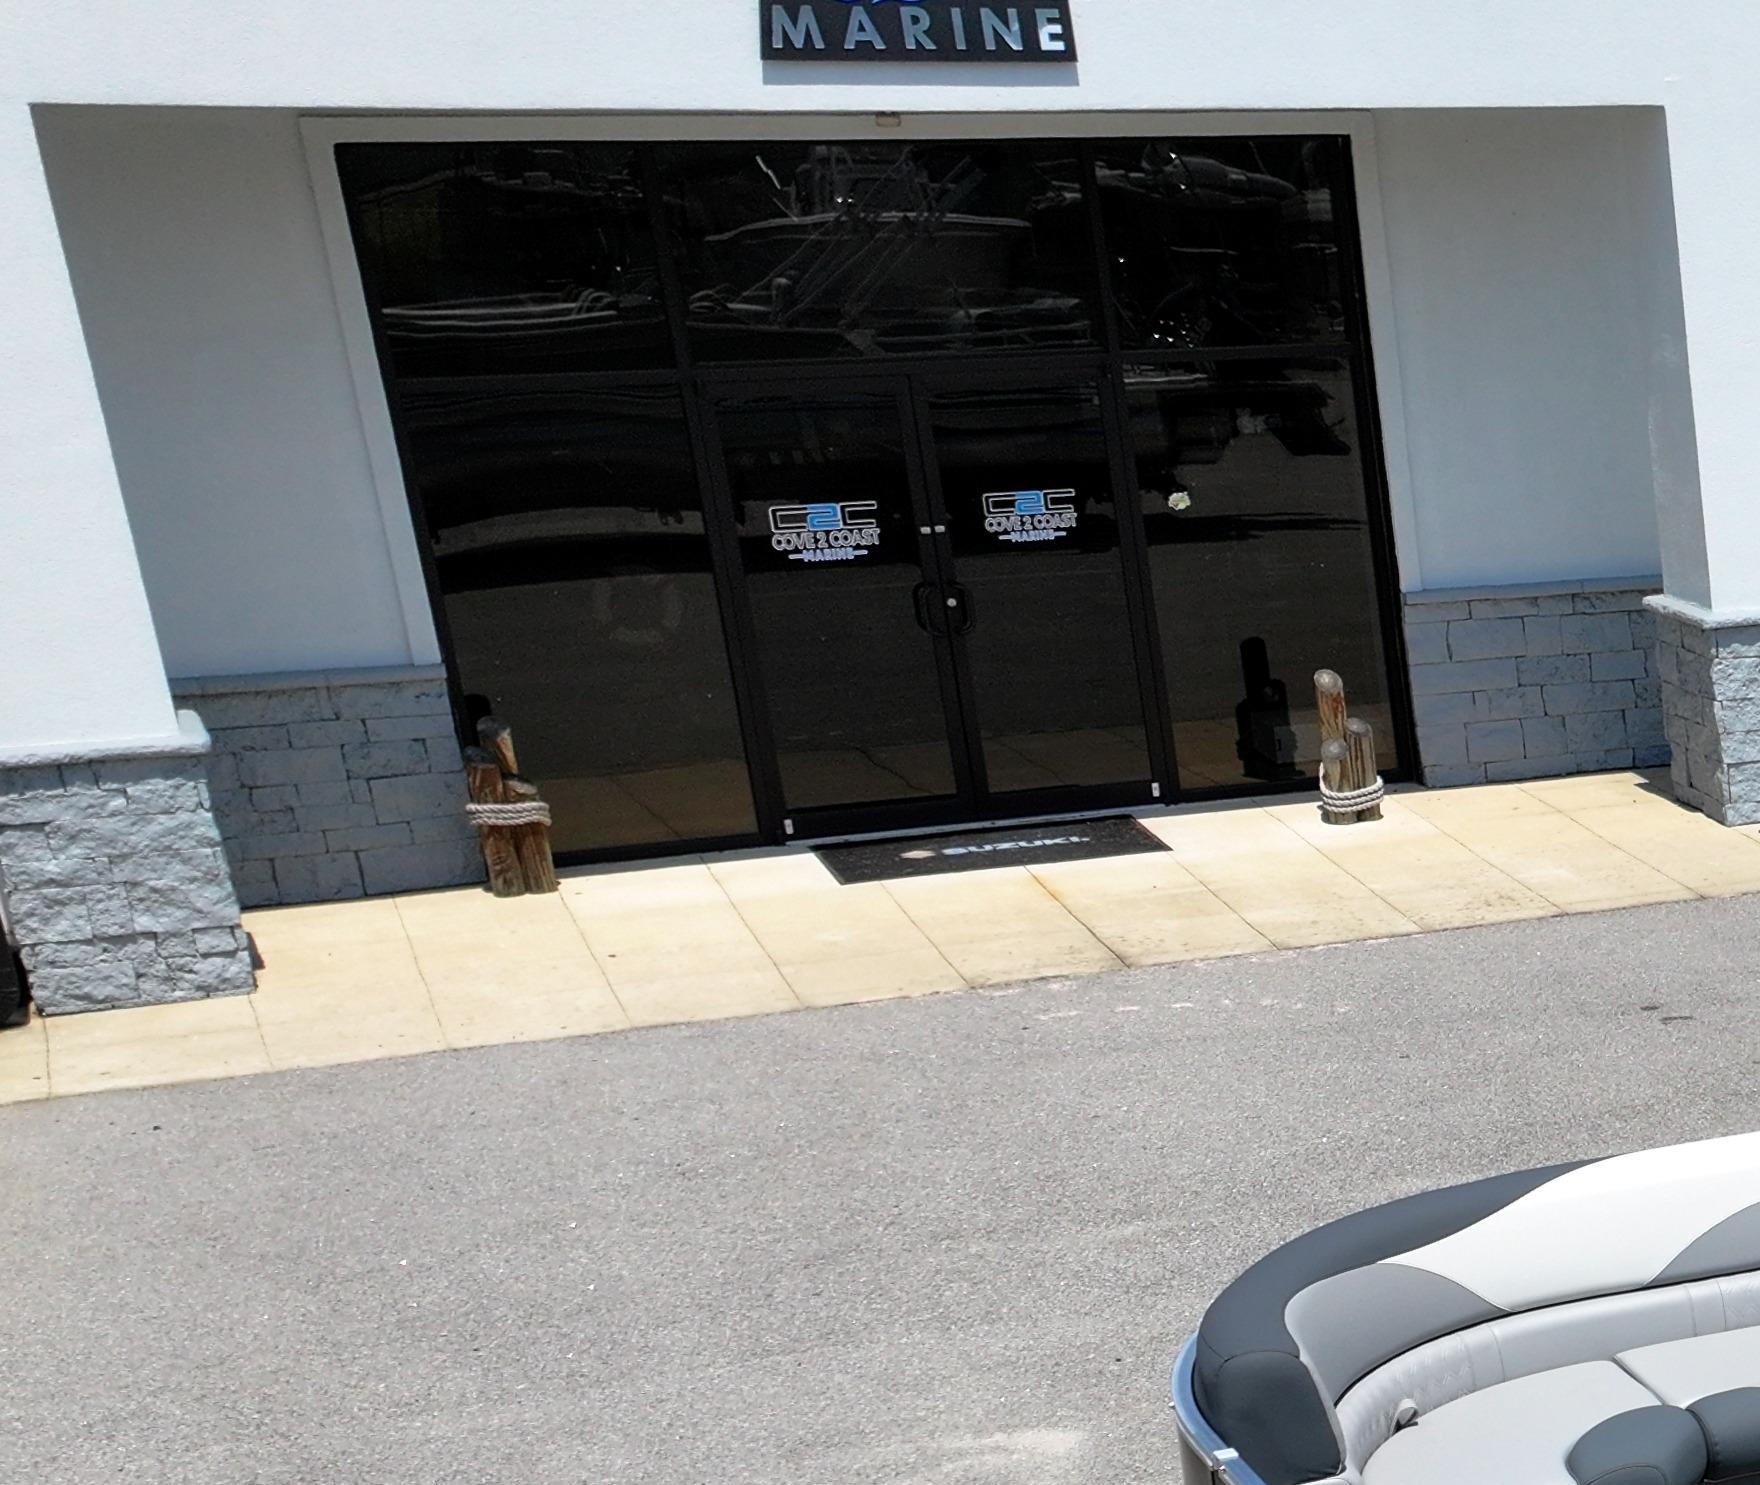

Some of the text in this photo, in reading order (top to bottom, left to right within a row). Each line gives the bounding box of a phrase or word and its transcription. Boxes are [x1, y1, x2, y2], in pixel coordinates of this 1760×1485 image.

[771, 5, 1066, 51] MARINE
[982, 488, 1076, 517] C2C
[768, 500, 878, 533] C2C
[984, 512, 1078, 533] COVE 2 COAST
[771, 528, 880, 551] COVE 2 COAST
[1010, 529, 1055, 542] MARINE
[802, 547, 854, 562] MARINE
